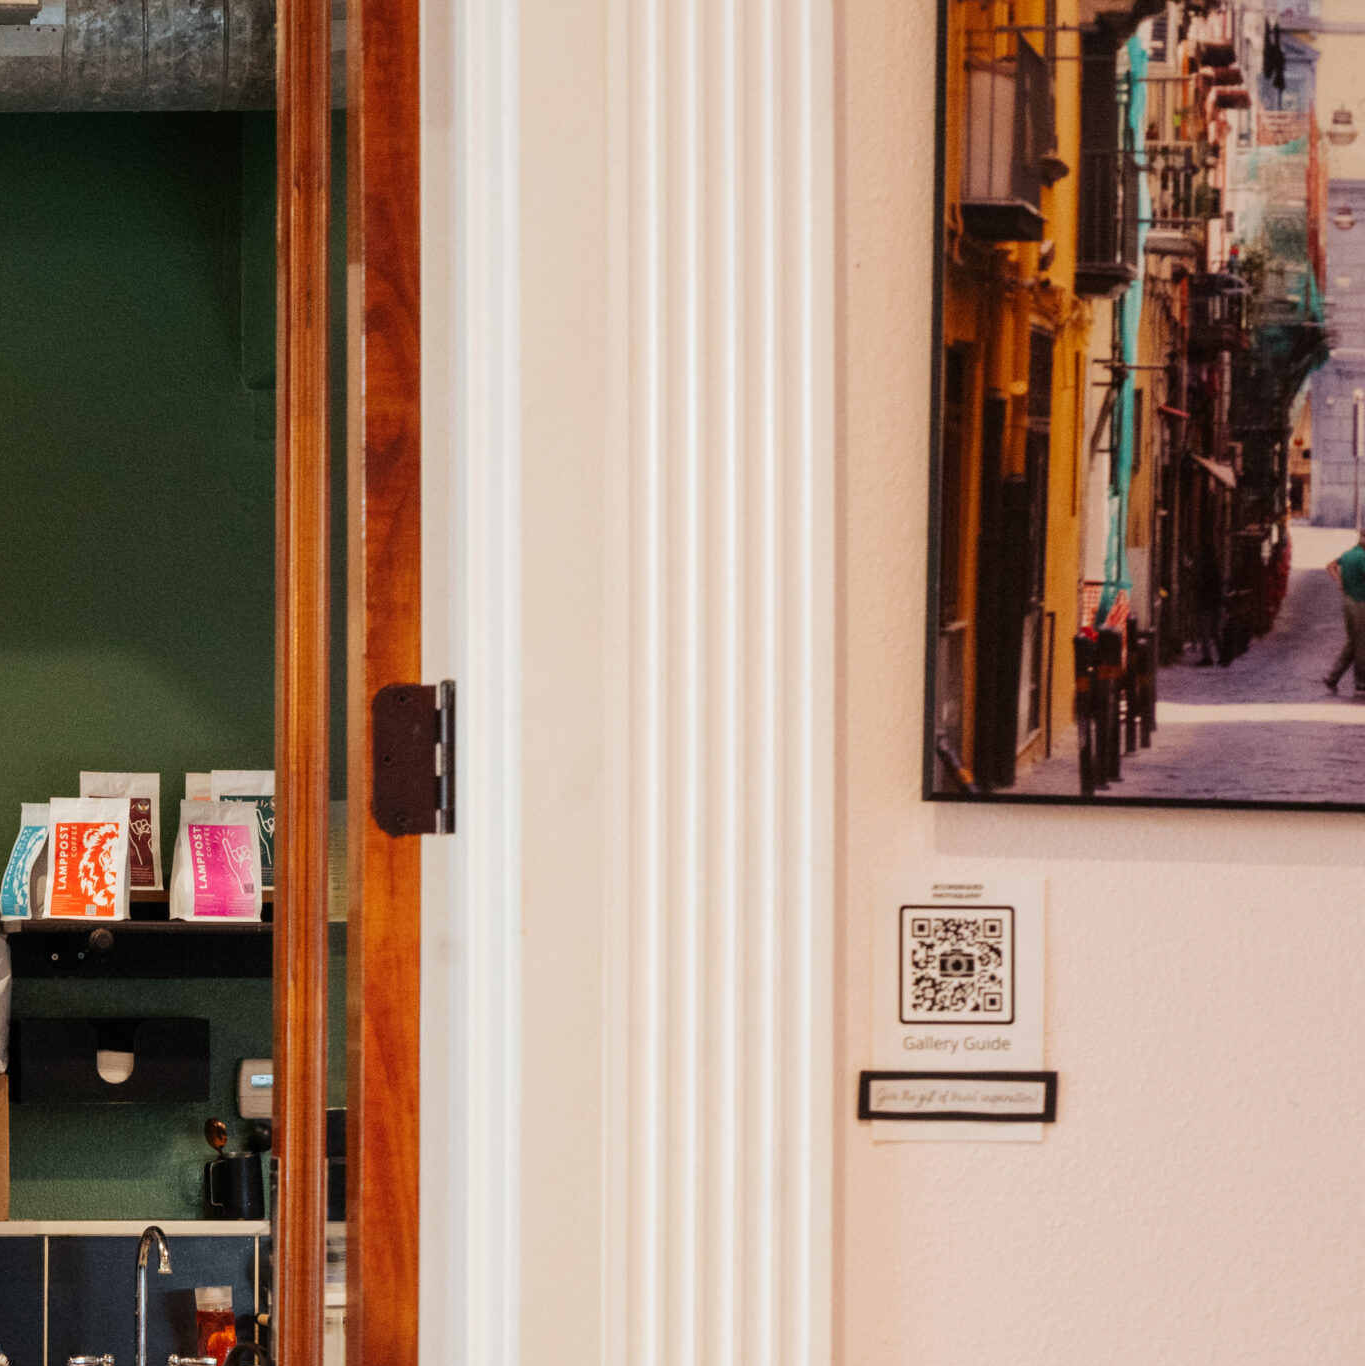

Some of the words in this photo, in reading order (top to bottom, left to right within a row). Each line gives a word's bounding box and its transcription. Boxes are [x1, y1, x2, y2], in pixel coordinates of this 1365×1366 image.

[57, 826, 69, 890] LAMPPOST
[193, 826, 208, 889] LAMPPOST
[203, 827, 212, 858] COFFEE
[902, 1035, 960, 1055] Gallery
[963, 1035, 1011, 1052] Guide
